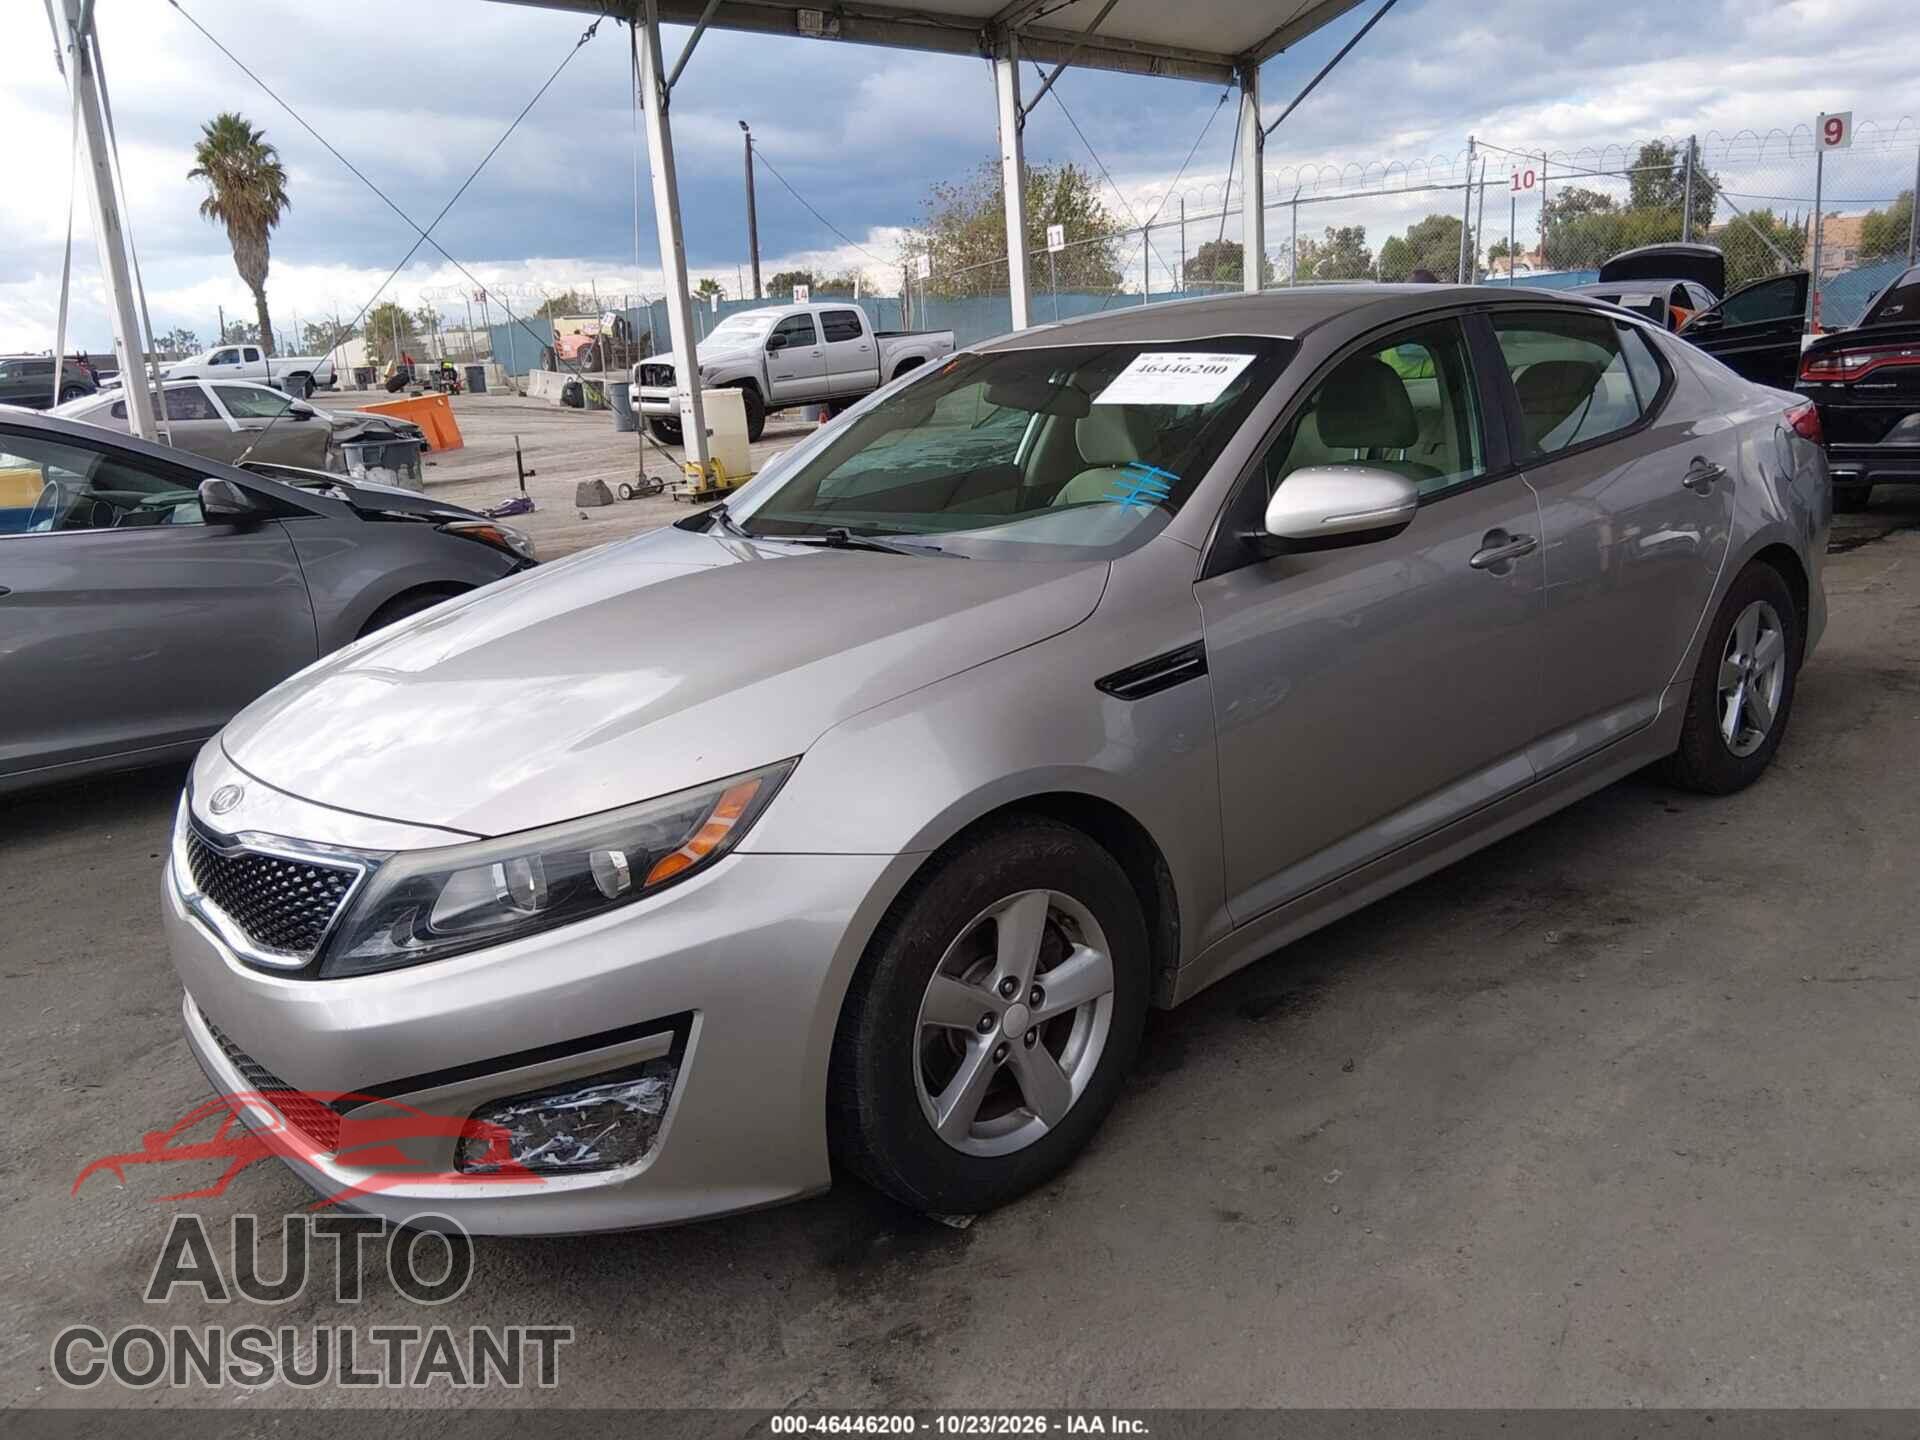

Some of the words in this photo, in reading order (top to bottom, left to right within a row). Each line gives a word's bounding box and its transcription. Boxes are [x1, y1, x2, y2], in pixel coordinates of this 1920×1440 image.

[1824, 118, 1843, 145] 9
[1511, 170, 1535, 191] 10
[1050, 231, 1062, 247] 11
[795, 288, 808, 301] 14
[1136, 363, 1228, 375] 46446200
